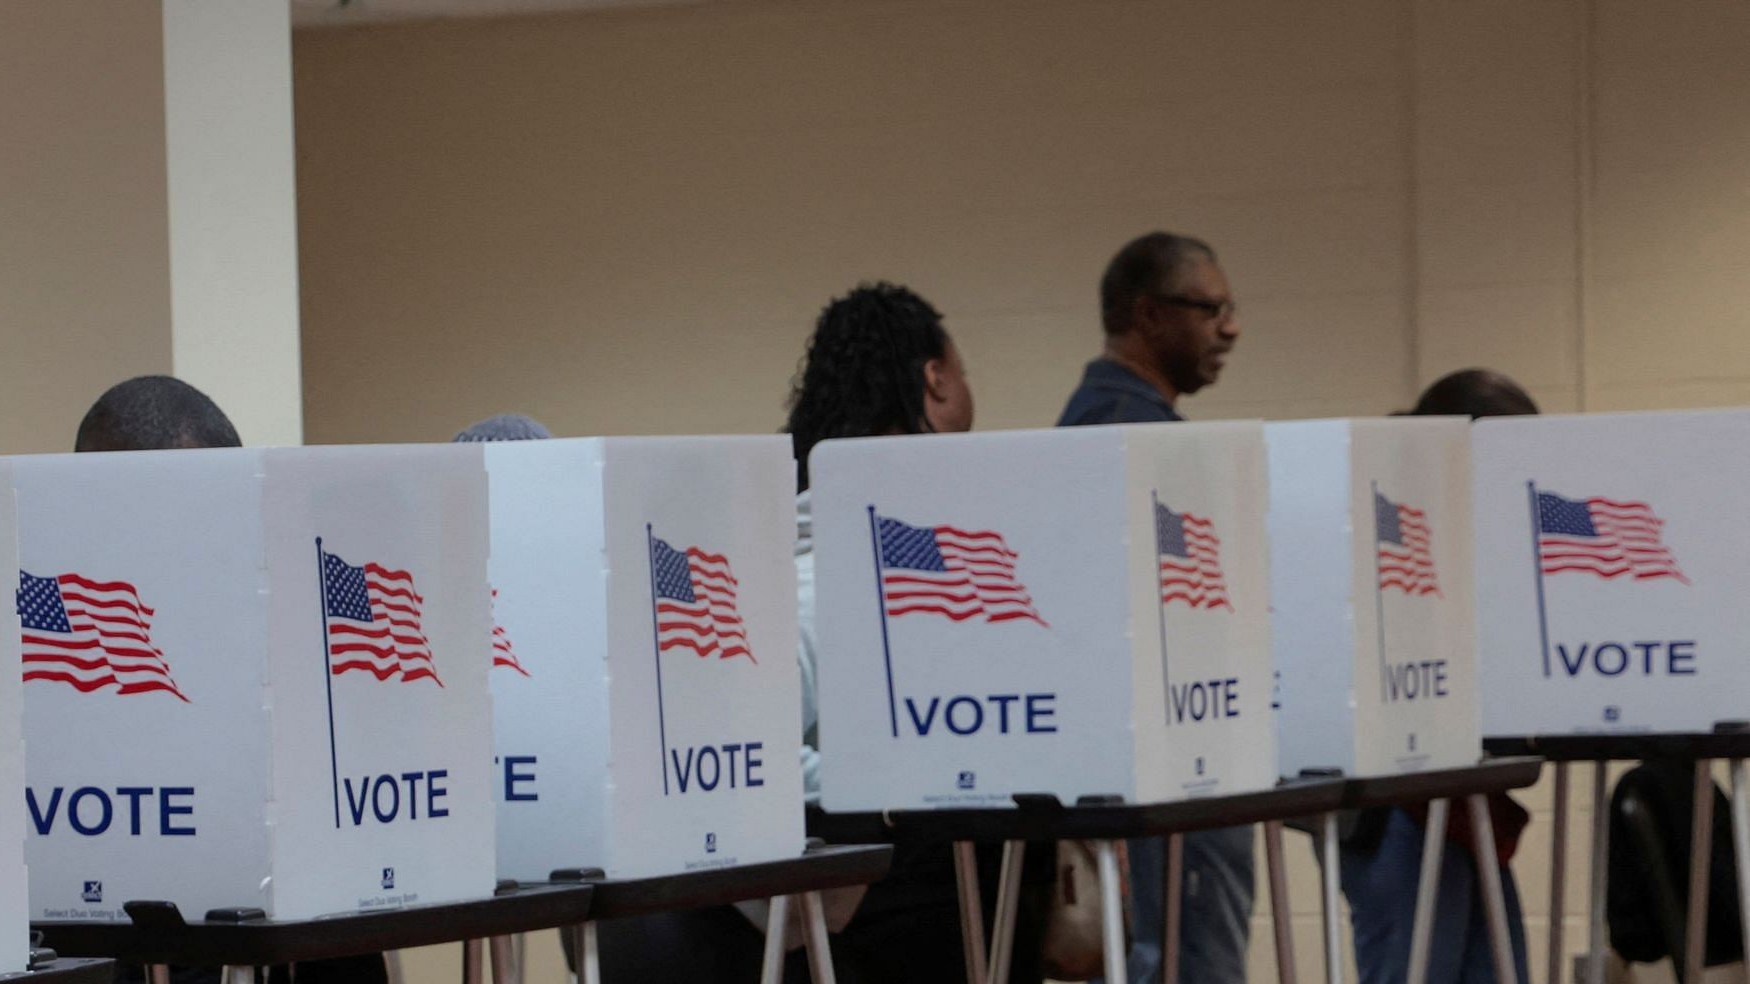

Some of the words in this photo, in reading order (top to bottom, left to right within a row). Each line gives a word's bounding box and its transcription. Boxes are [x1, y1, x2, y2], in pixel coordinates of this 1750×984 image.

[1387, 660, 1448, 701] VOTE
[1554, 641, 1696, 677] VOTE
[905, 694, 1058, 737] VOTE
[1171, 679, 1240, 722] VOTE
[671, 742, 765, 793] VOTE
[25, 786, 197, 836] VOTE
[343, 769, 450, 825] VOTE
